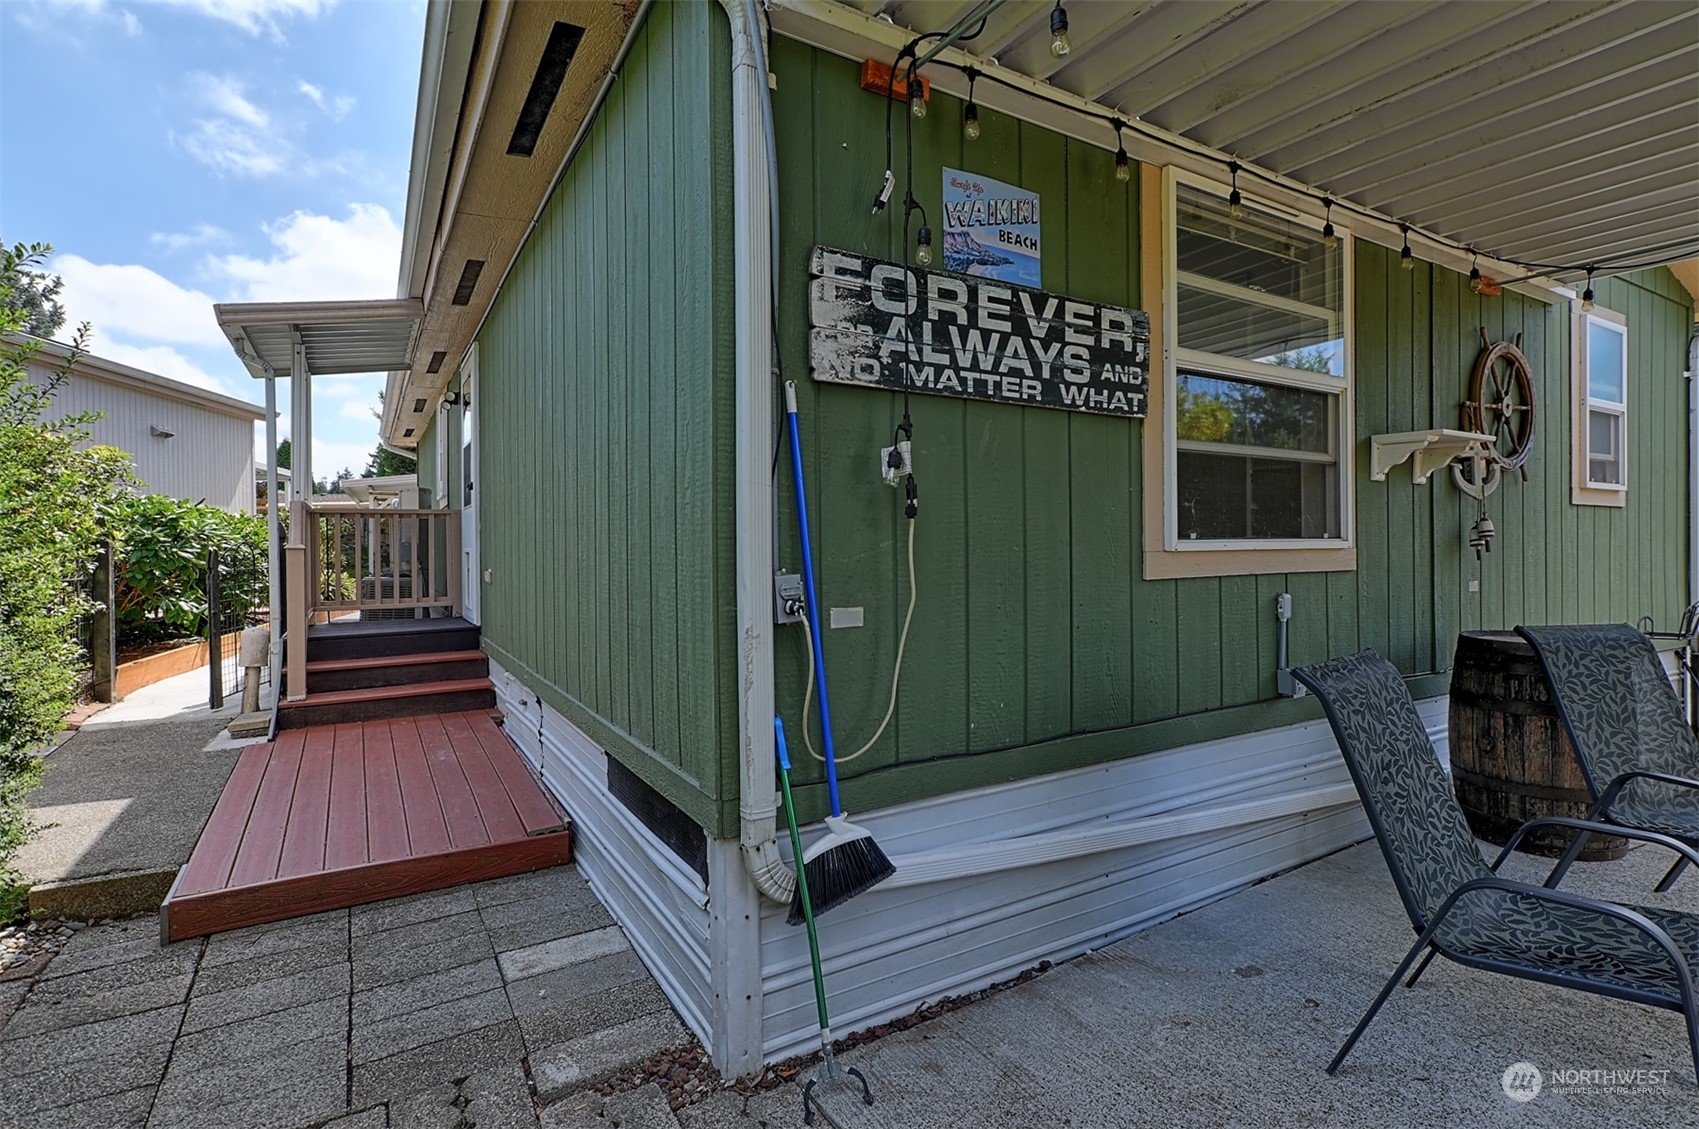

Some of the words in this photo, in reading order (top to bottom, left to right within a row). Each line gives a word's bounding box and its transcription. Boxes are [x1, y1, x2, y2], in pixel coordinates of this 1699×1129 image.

[945, 199, 1039, 228] WAIKIKI
[999, 229, 1037, 251] BEACH
[879, 316, 1091, 384] ALWAYS
[1100, 363, 1142, 385] AND
[903, 361, 1042, 400] MATTER
[1059, 383, 1144, 412] WHAT
